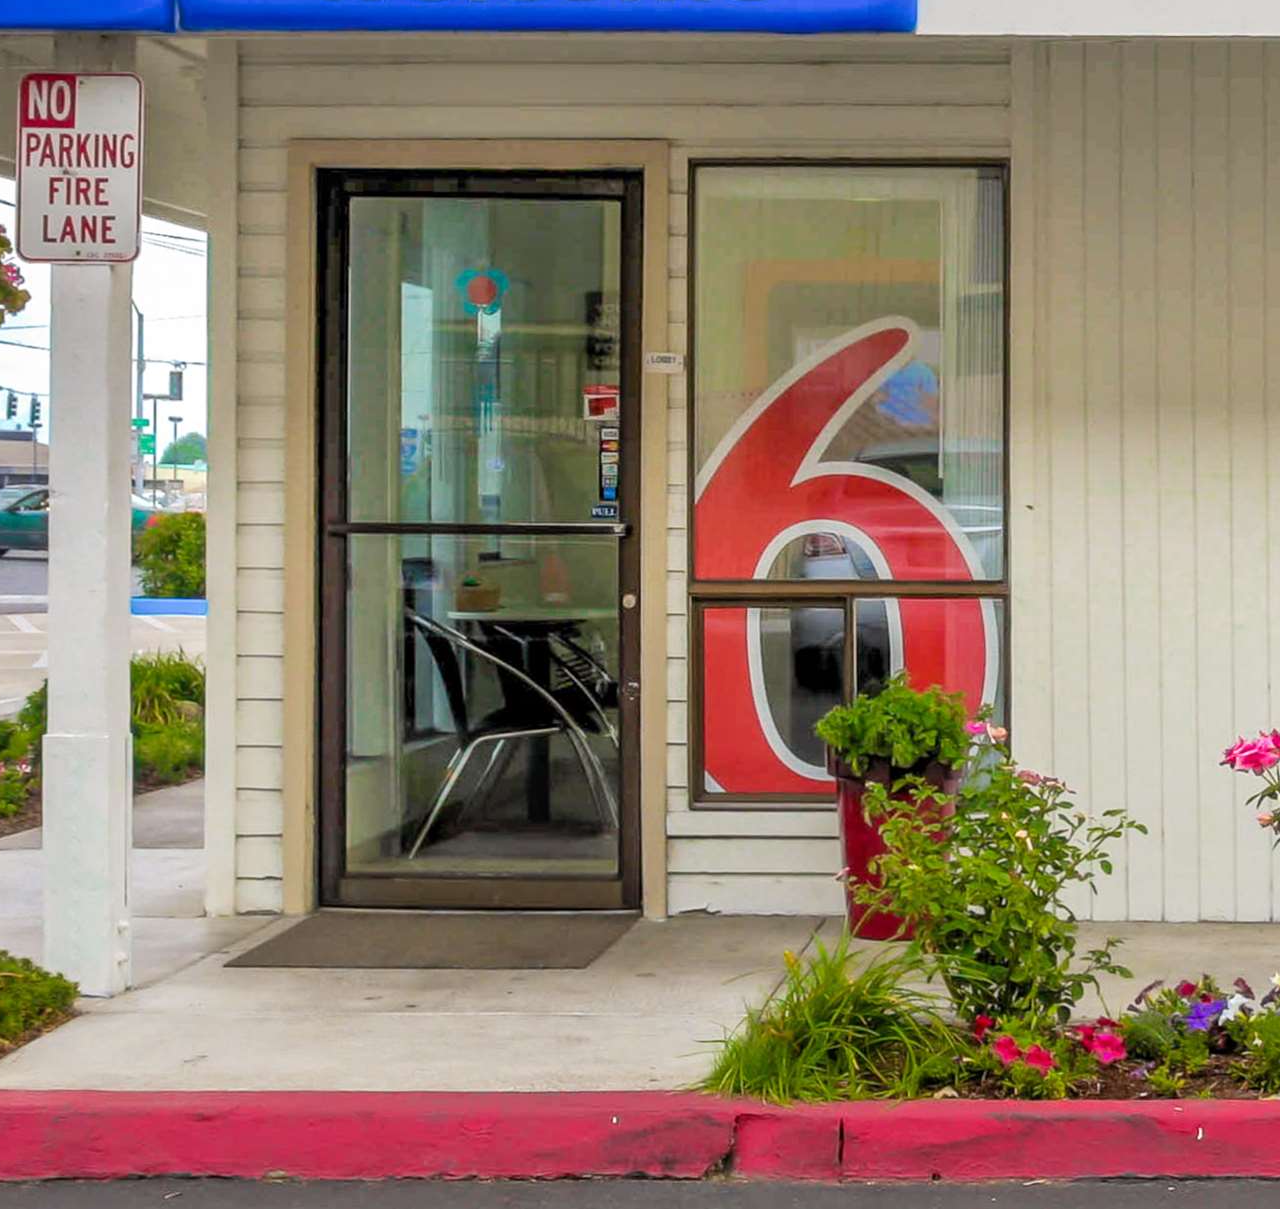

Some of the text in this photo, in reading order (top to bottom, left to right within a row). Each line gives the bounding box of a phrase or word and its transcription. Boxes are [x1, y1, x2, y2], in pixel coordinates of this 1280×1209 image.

[28, 79, 72, 122] NO
[25, 133, 135, 169] PARKING
[48, 177, 110, 206] FIRE
[42, 214, 117, 244] LANE
[695, 316, 1000, 793] 6
